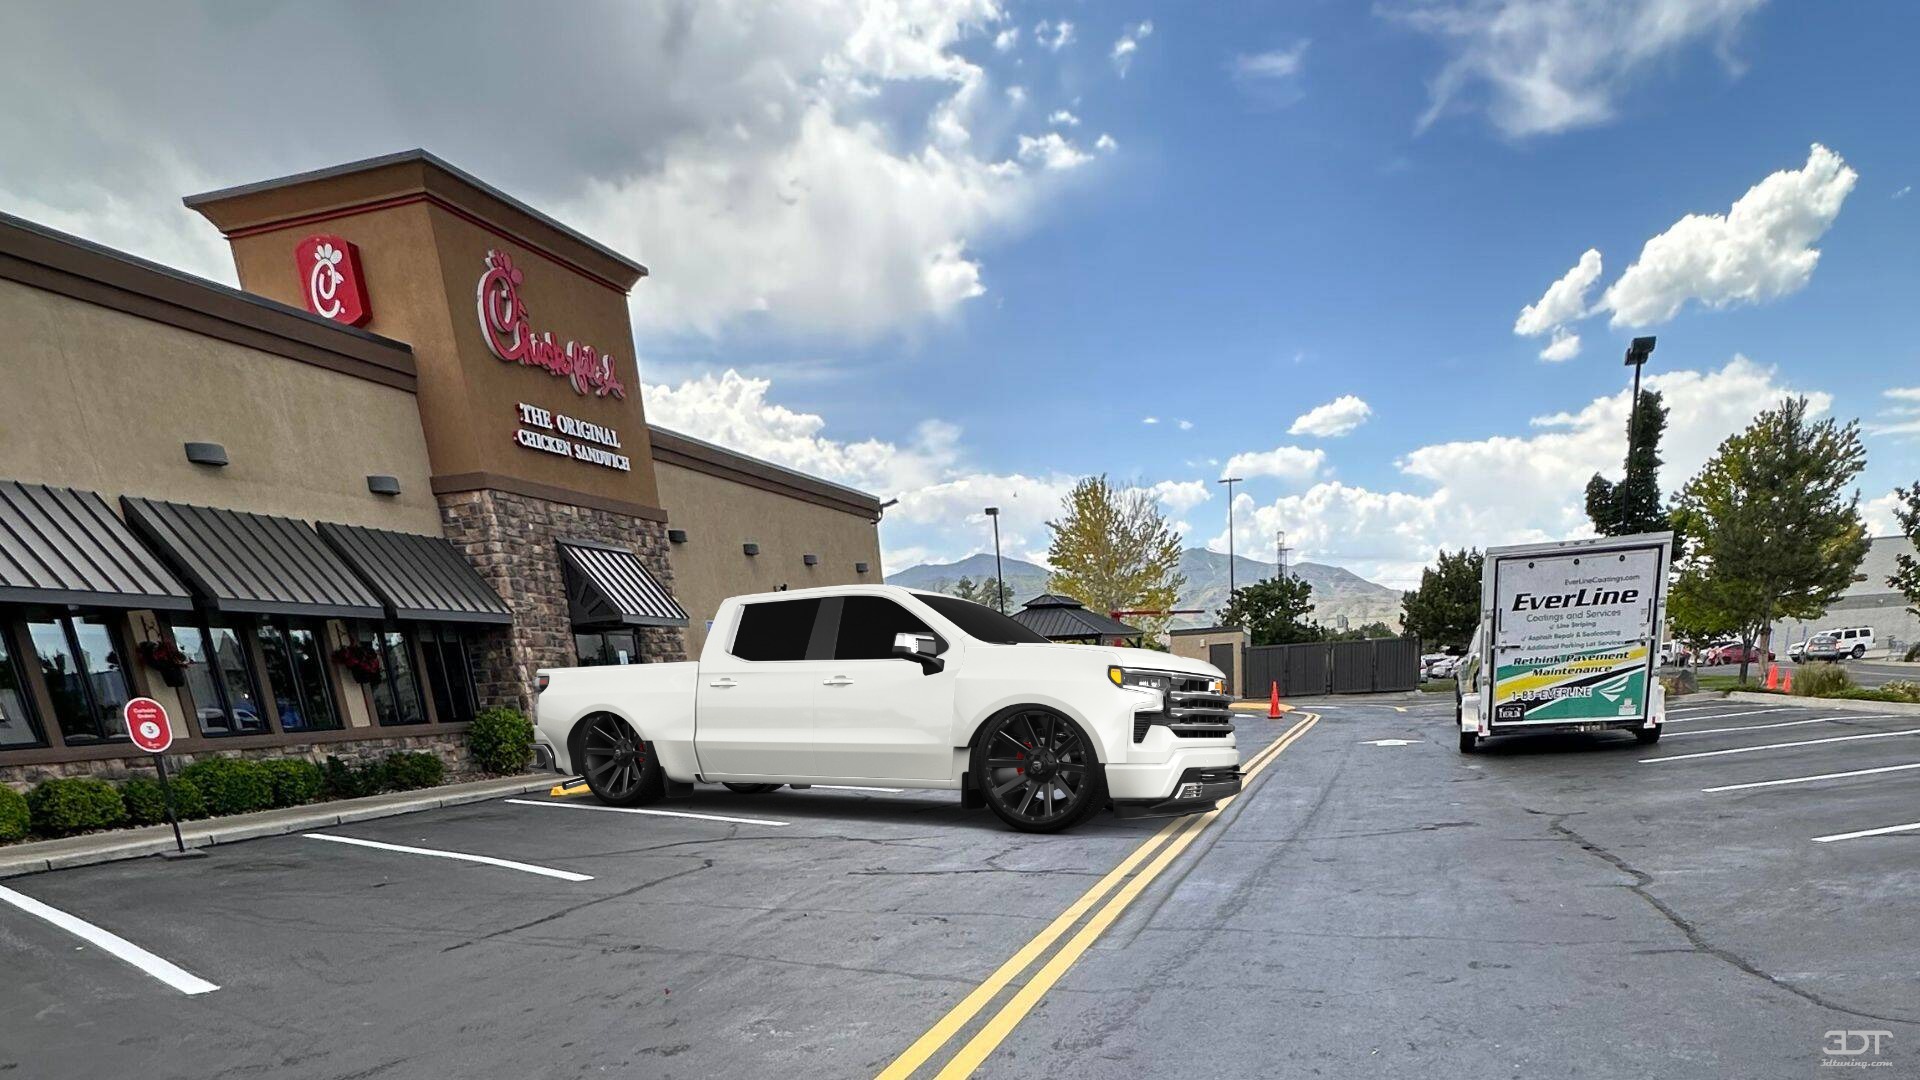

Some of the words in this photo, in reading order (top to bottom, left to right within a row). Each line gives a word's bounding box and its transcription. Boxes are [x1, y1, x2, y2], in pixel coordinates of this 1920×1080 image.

[517, 402, 553, 430] THE
[556, 414, 621, 449] ORIGINAL
[516, 428, 573, 457] CHICKEN
[574, 443, 631, 472] SANDWICH
[1564, 574, 1640, 586] EverLineCoatings.com
[1511, 587, 1639, 612] EverLine
[1526, 613, 1564, 623] Coatings
[1566, 611, 1584, 620] and
[1586, 609, 1621, 619] Services
[1513, 656, 1560, 666] Rethink
[1566, 651, 1630, 662] Pavement
[1532, 665, 1613, 677] Maintenance
[146, 725, 153, 734] 3
